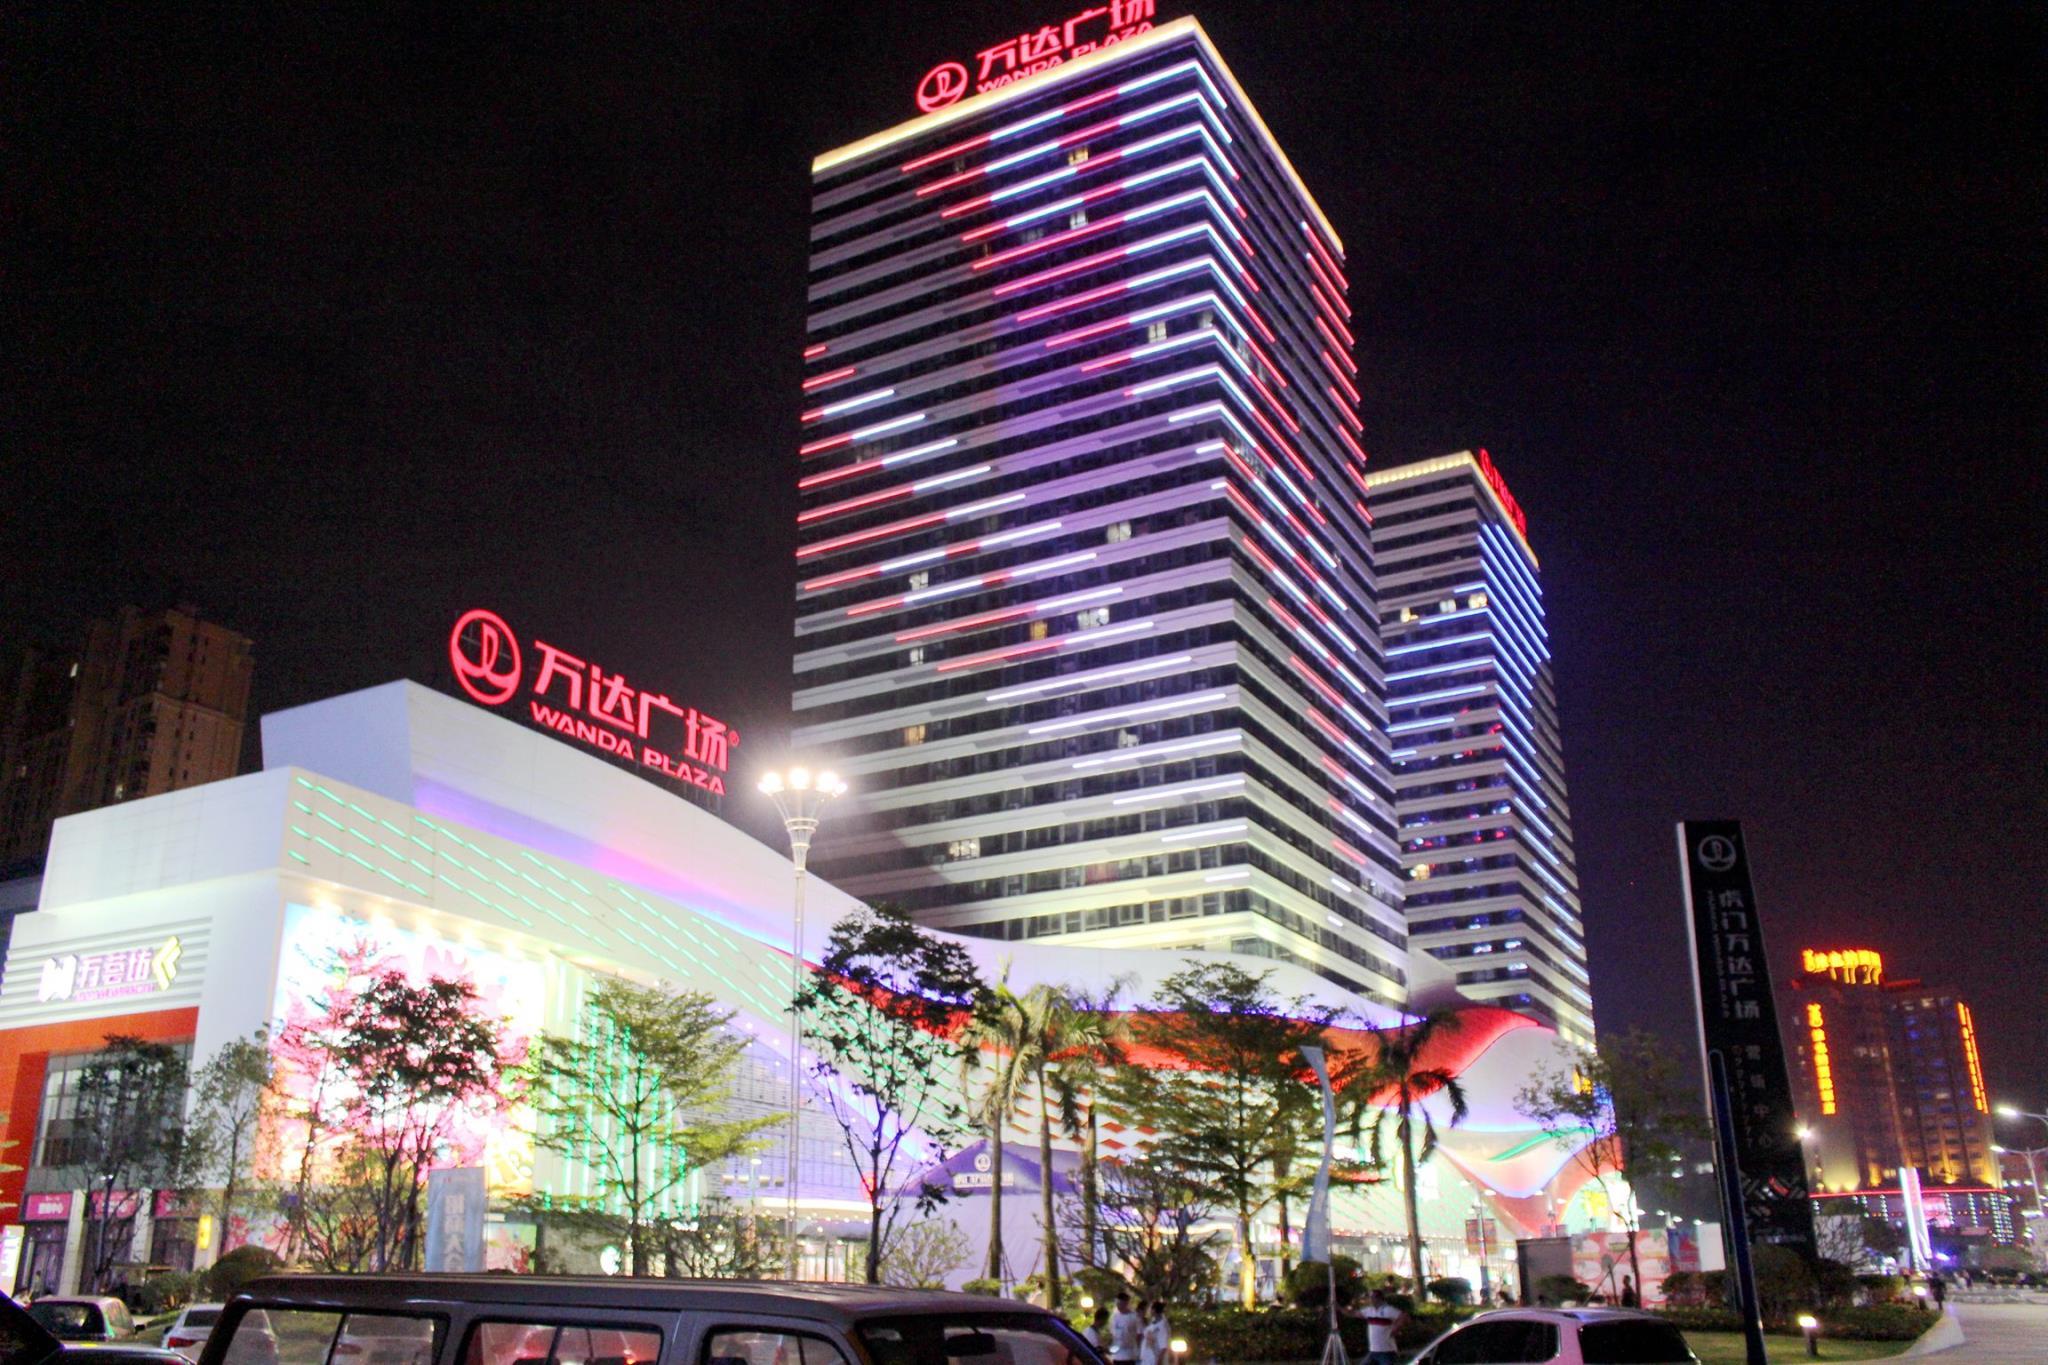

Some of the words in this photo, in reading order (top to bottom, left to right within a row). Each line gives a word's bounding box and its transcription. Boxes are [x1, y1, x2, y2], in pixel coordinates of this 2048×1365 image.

[975, 0, 1155, 81] 万达广场
[976, 54, 1064, 94] WANDA
[1071, 21, 1155, 59] PLAZA
[529, 701, 635, 761] WANDA
[642, 746, 726, 796] PLAZA
[533, 639, 729, 772] 万达广场
